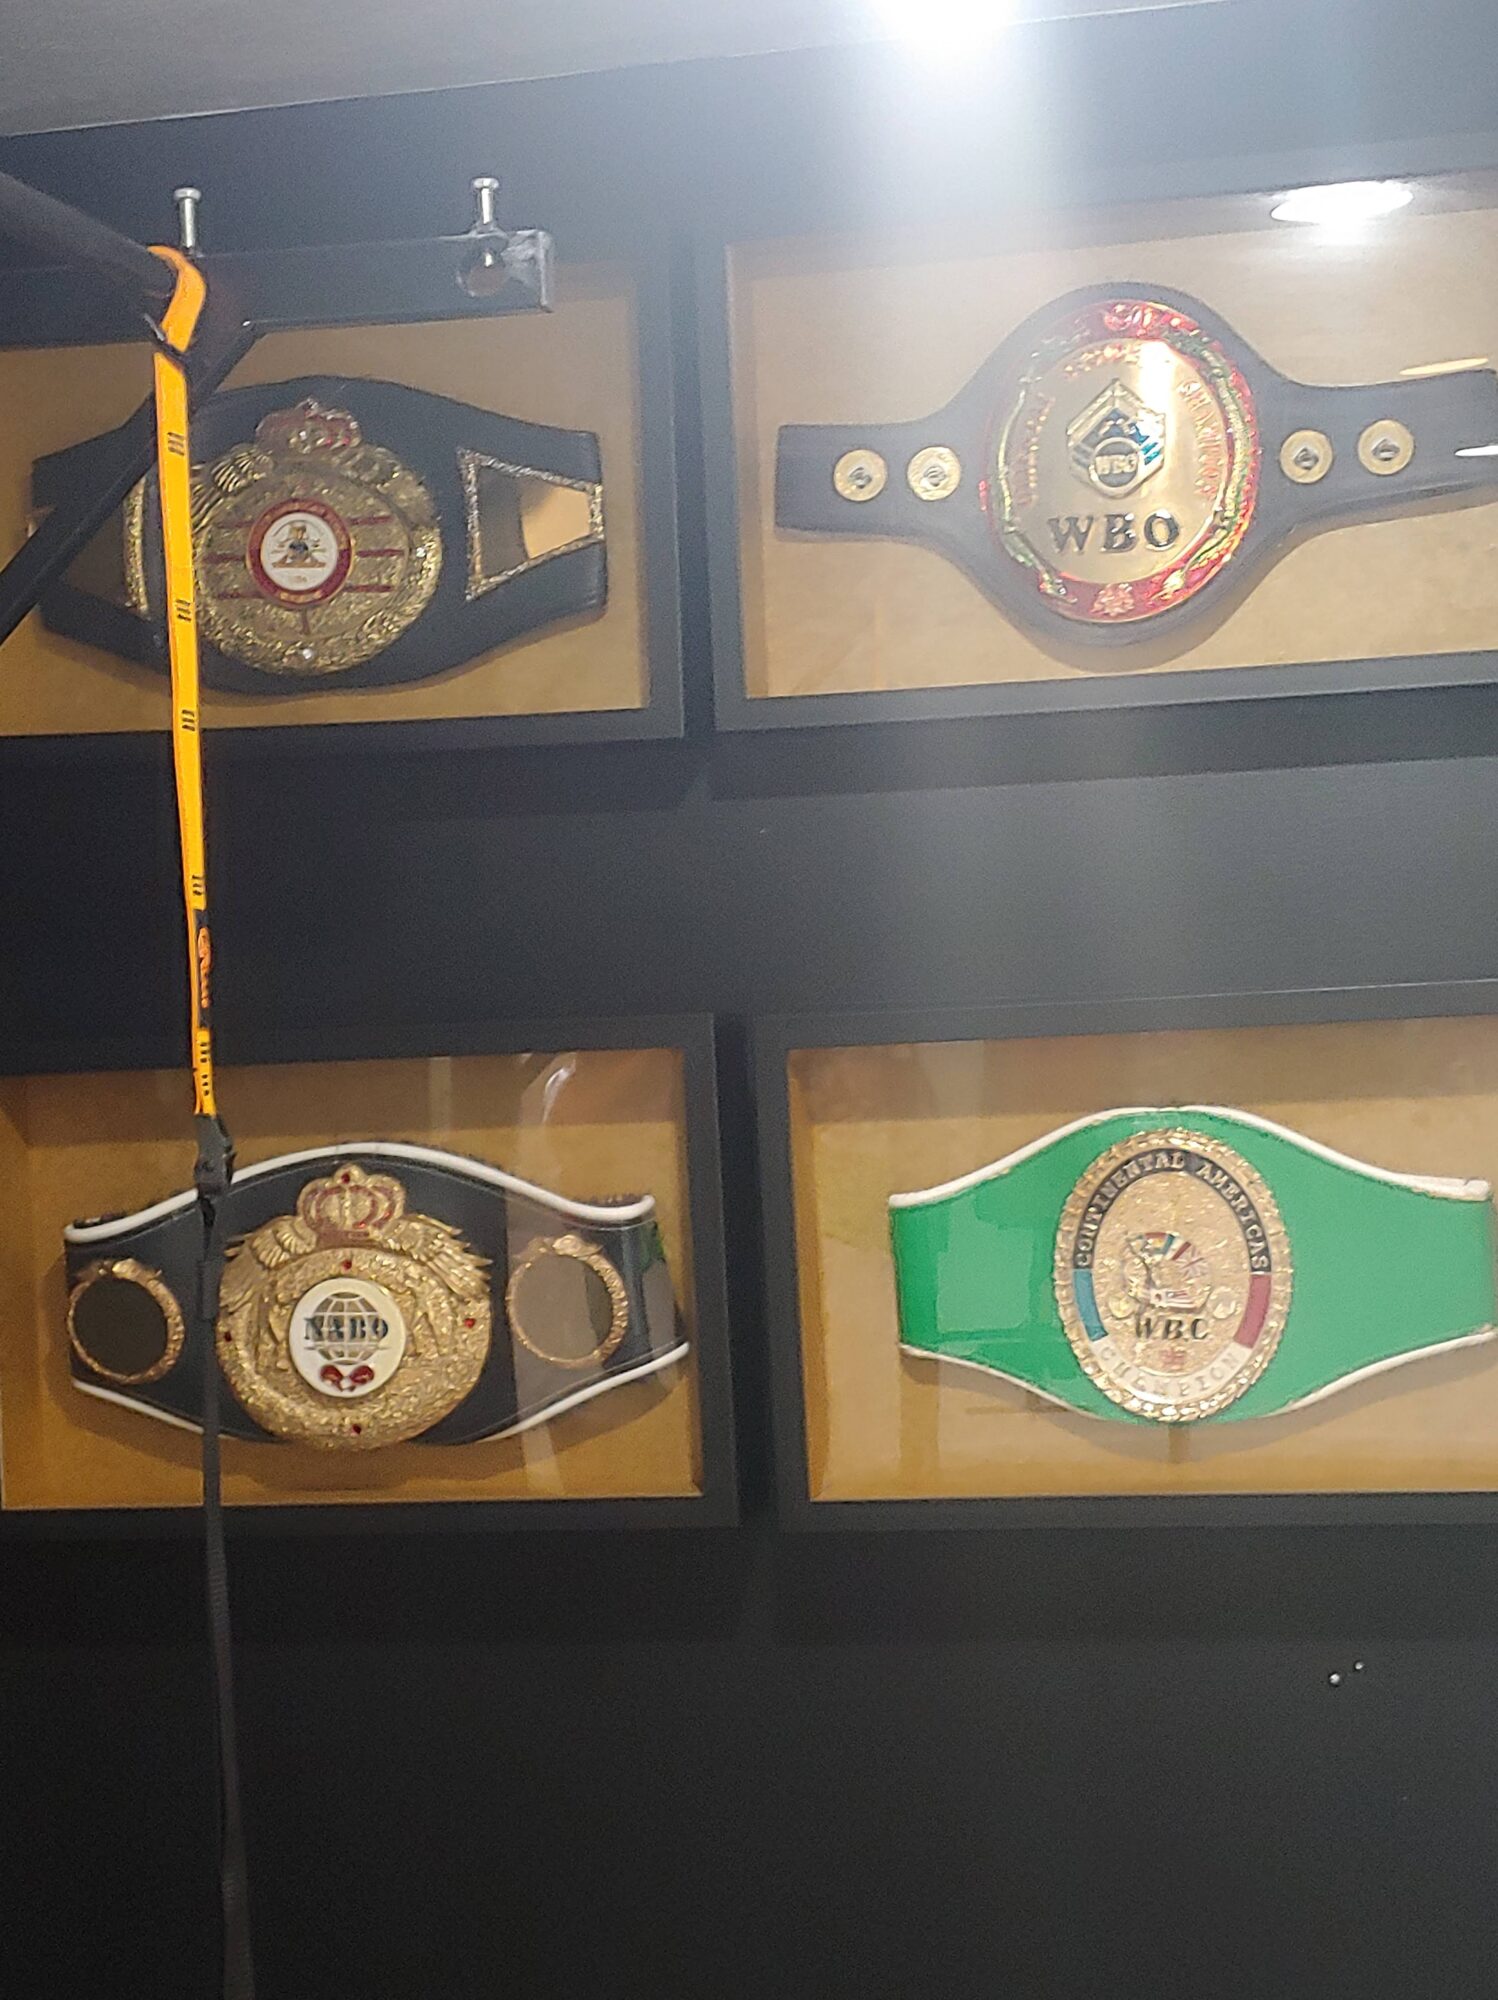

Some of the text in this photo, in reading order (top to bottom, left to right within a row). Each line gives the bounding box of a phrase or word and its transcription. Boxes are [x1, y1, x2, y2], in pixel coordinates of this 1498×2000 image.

[1048, 511, 1180, 553] WBO
[1075, 1151, 1269, 1269] CONTINENTAL AMERICAS
[304, 1316, 388, 1340] NABO
[1134, 1317, 1210, 1340] WBC
